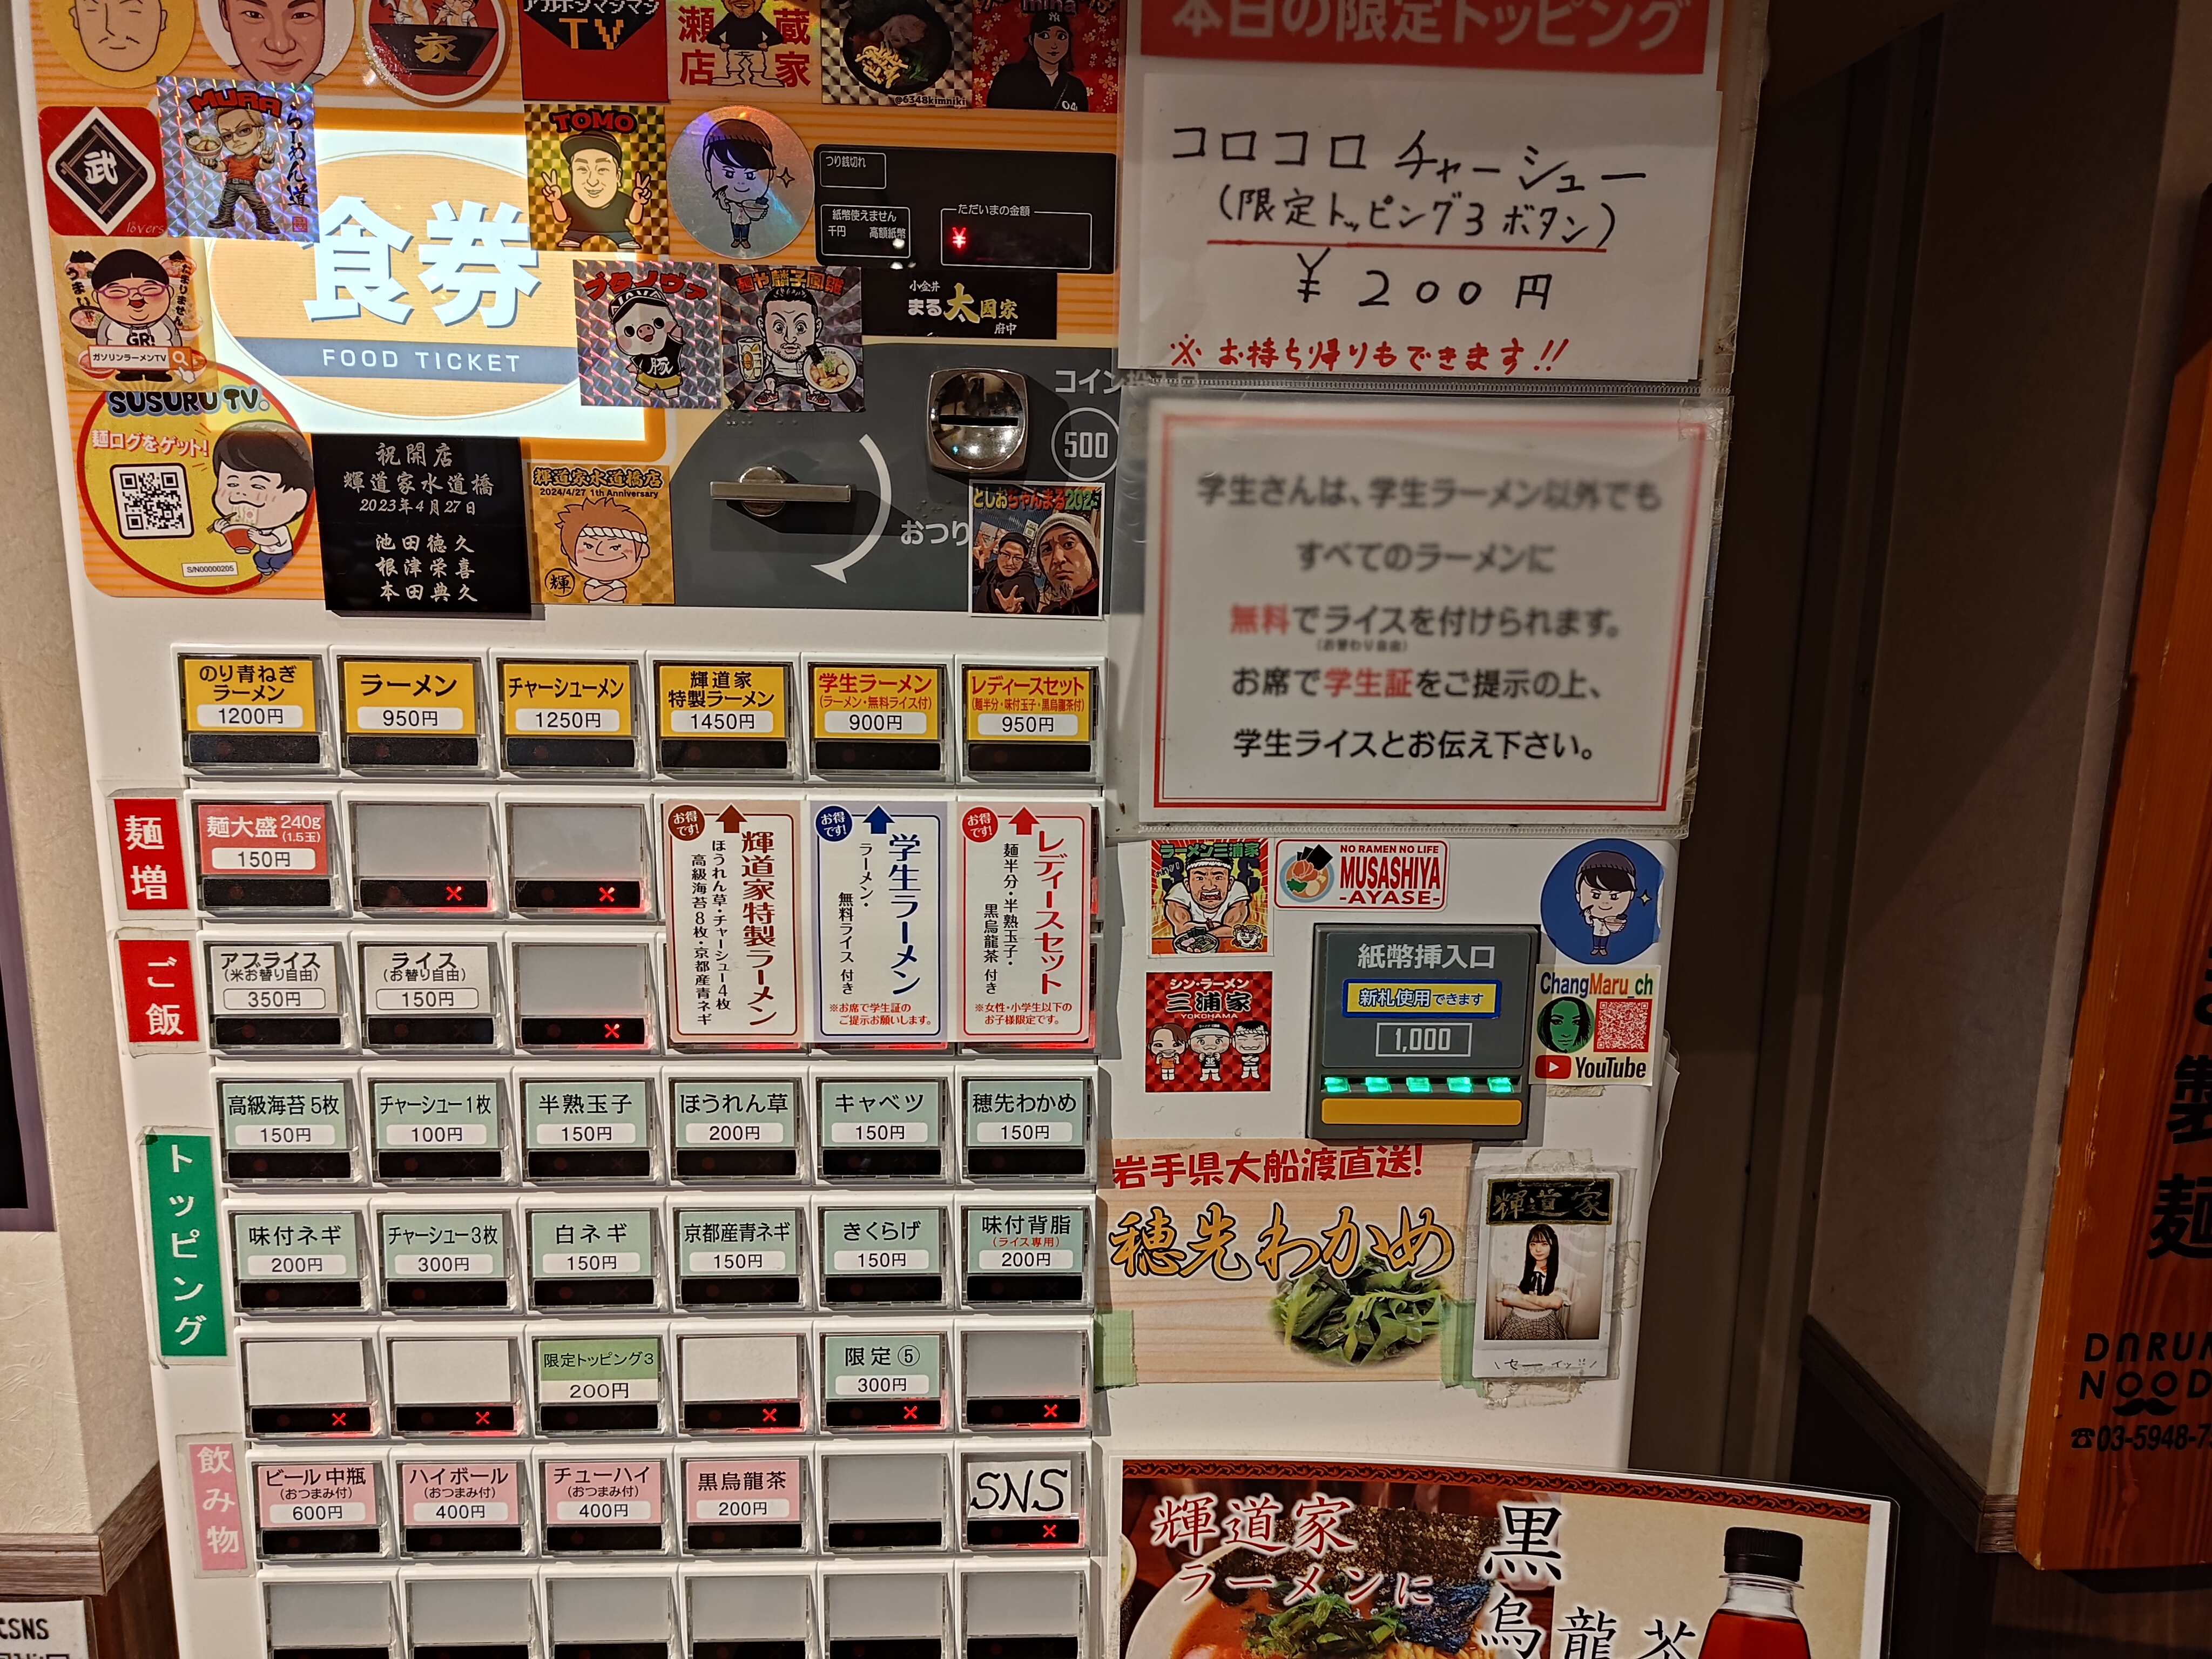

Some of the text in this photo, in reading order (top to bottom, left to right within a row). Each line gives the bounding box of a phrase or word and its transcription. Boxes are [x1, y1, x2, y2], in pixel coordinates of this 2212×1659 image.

[559, 18, 624, 50] TV
[414, 32, 462, 64] 家
[187, 89, 281, 118] MURA
[552, 111, 636, 133] TOMO
[287, 104, 311, 208] らーめん道
[826, 155, 866, 168] つり銭切れ
[84, 150, 117, 185] 武
[832, 209, 897, 222] 紙幣使えません
[958, 204, 1030, 217] ただいまの金額
[126, 222, 164, 233] lovers
[827, 225, 906, 240] 千円 高額紙幣
[302, 195, 540, 327] 食券
[66, 268, 91, 308] うまい
[583, 271, 709, 301] ブタノヴァ
[909, 280, 940, 292] 小金井
[994, 322, 1017, 335] 府中
[92, 353, 167, 363] ガソリンラーメンTV
[323, 348, 521, 372] FOOD TICKET
[646, 357, 673, 375] 豚
[108, 391, 217, 414] SUSURU
[1064, 431, 1109, 458] 500
[343, 471, 494, 496] 輝道家水道橋
[532, 467, 664, 488] 輝道家水道橋店
[540, 489, 585, 497] 2024/4/27
[606, 489, 659, 499] Anniversary
[1298, 541, 1554, 575] すべてのラーメンに
[186, 565, 234, 574] S/N00000205
[199, 665, 298, 684] のり青ねぎ
[360, 673, 457, 697] ラーメン
[690, 671, 753, 690] 輝道家
[819, 673, 933, 694] 学生ラーメン
[1231, 667, 1602, 700] お席で学生証をご提示の上、
[213, 684, 285, 702] ラーメン
[508, 677, 625, 699] チャーシューメン
[972, 675, 1084, 697] レディースセット
[668, 690, 775, 709] 特製ラーメン
[218, 707, 284, 724] 1200円
[383, 710, 439, 727] 950円
[535, 712, 601, 729] 1250円
[691, 713, 755, 730] 1450円
[849, 714, 903, 731] 900円
[1002, 716, 1054, 732] 950円
[1233, 729, 1595, 761] 学生ライスとお伝え下さい。
[207, 814, 322, 839] 麺大盛 240g
[281, 831, 322, 844] (1.5玉)
[124, 814, 168, 901] 麺増
[237, 851, 291, 868] 150円
[1160, 842, 1260, 859] ラーメン三浦家
[1340, 845, 1439, 854] NO RAMEN NO LIFE
[1339, 856, 1441, 890] MUSASHIYA
[888, 833, 921, 995] 学生ラーメン
[1034, 831, 1067, 995] レディースセット
[711, 840, 732, 1010] ほうれん草・チャーシュー4枚
[741, 831, 777, 1026] 輝道家特製ラーメン
[691, 853, 712, 1026] 高級海苔8枚・京都産青ネギ
[220, 952, 322, 970] アブライス
[391, 952, 457, 970] ライス
[1357, 943, 1495, 970] 紙幣挿入口
[145, 956, 184, 1036] ご飯
[247, 991, 301, 1008] 350円
[401, 991, 455, 1008] 150円
[1165, 992, 1252, 1014] 三浦家
[1359, 988, 1484, 1008] 新札使用できます
[839, 1015, 931, 1026] ご提示お願いします。
[984, 1014, 1060, 1026] お子様限定です。
[1395, 1028, 1452, 1053] 1,000
[1575, 1056, 1647, 1079] YouTube
[228, 1095, 340, 1116] 高級海苔5枚
[380, 1094, 491, 1115] チャーシュー1枚
[538, 1093, 632, 1115] 半熟玉子
[680, 1093, 788, 1114] ほうれん草
[834, 1093, 924, 1114] キャベツ
[972, 1092, 1077, 1114] 穂先わかめ
[260, 1127, 312, 1143] 150円
[411, 1127, 463, 1142] 100円
[562, 1126, 612, 1142] 150円
[709, 1125, 760, 1141] 200円
[855, 1125, 905, 1140] 150円
[1001, 1124, 1050, 1140] 150円
[248, 1225, 342, 1246] 味付ネギ
[388, 1225, 498, 1246] チャーシュー3枚
[556, 1223, 628, 1244] 白ネギ
[684, 1222, 791, 1243] 京都産青ネギ
[843, 1220, 921, 1242] きくらげ
[981, 1215, 1071, 1236] 味付背脂
[168, 1144, 207, 1346] トッピング
[1108, 1201, 1456, 1282] 穂先わかめ
[271, 1257, 323, 1273] 200円
[417, 1256, 470, 1272] 300円
[567, 1255, 617, 1271] 150円
[713, 1254, 763, 1270] 150円
[858, 1253, 907, 1268] 150円
[1002, 1252, 1051, 1267] 200円
[543, 1352, 655, 1368] 限定トッピング3
[569, 1383, 630, 1400] 200円
[857, 1377, 908, 1393] 300円
[2096, 1423, 2212, 1452] 03-5948-7
[409, 1467, 509, 1486] ハイボール
[554, 1466, 651, 1485] チューハイ
[697, 1470, 787, 1492] 黒烏龍茶
[197, 1446, 239, 1554] 飲み物
[970, 1469, 1069, 1513] SNS
[292, 1505, 343, 1521] 600円
[435, 1505, 485, 1520] 400円
[579, 1502, 629, 1518] 400円
[718, 1501, 768, 1516] 200円
[1154, 1494, 1355, 1554] 輝道家
[1178, 1563, 1434, 1604] ラーメンに
